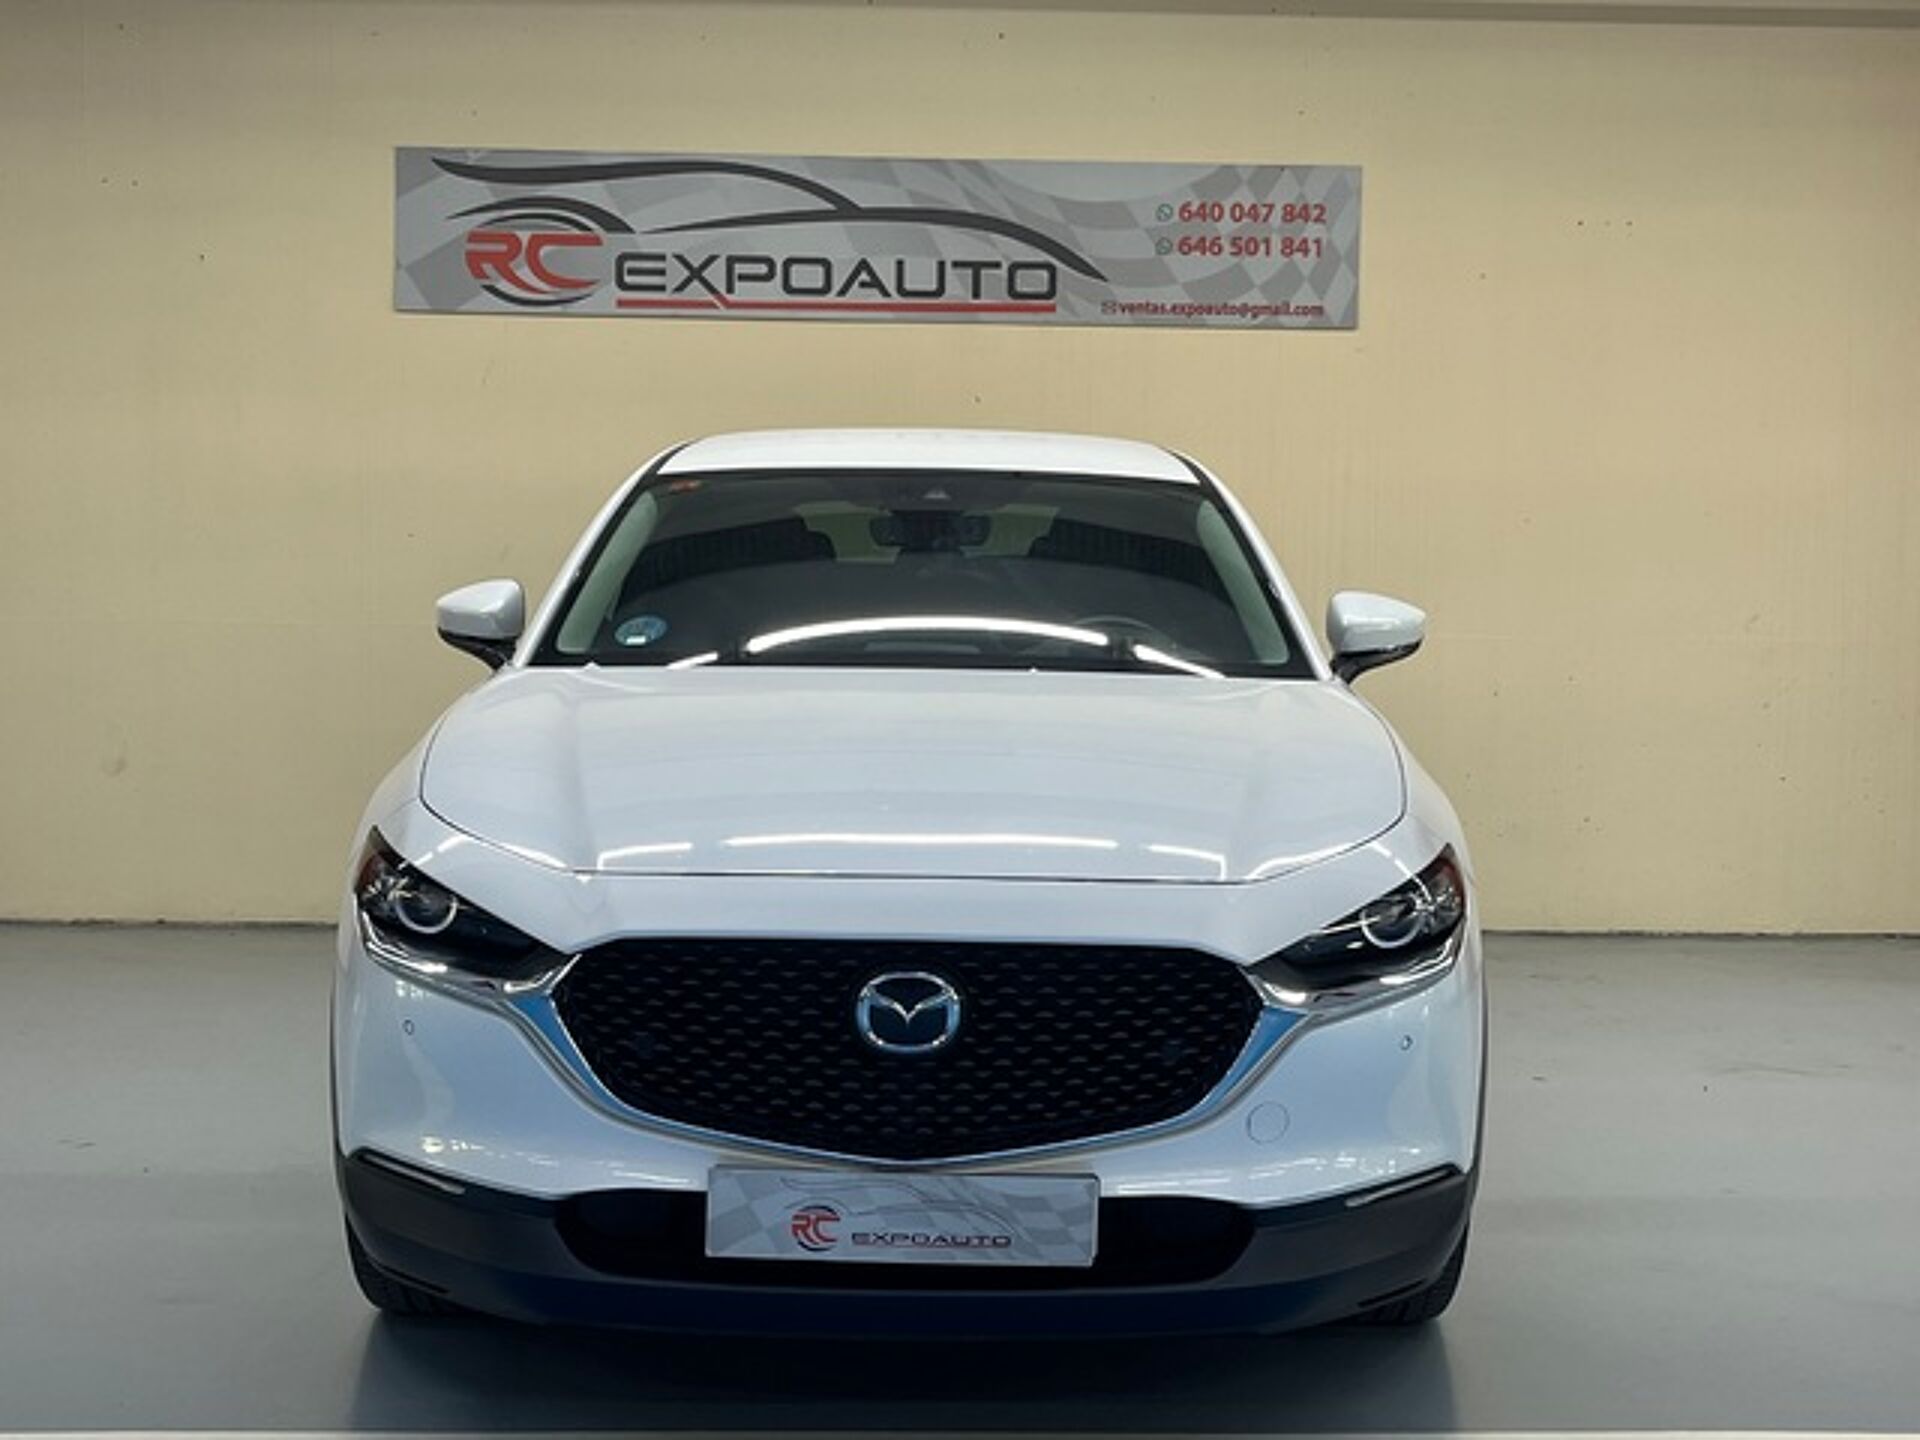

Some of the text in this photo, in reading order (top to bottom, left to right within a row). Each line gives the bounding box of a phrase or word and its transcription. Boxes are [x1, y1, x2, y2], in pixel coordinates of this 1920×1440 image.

[1178, 202, 1327, 224] 640 047 842
[1177, 235, 1322, 258] 646 501 841
[464, 231, 1057, 301] RC EXPOAUTO
[1118, 301, 1325, 319] ventas.expoauto@gmail.com
[791, 1213, 1013, 1249] RC EXPOAUTO
